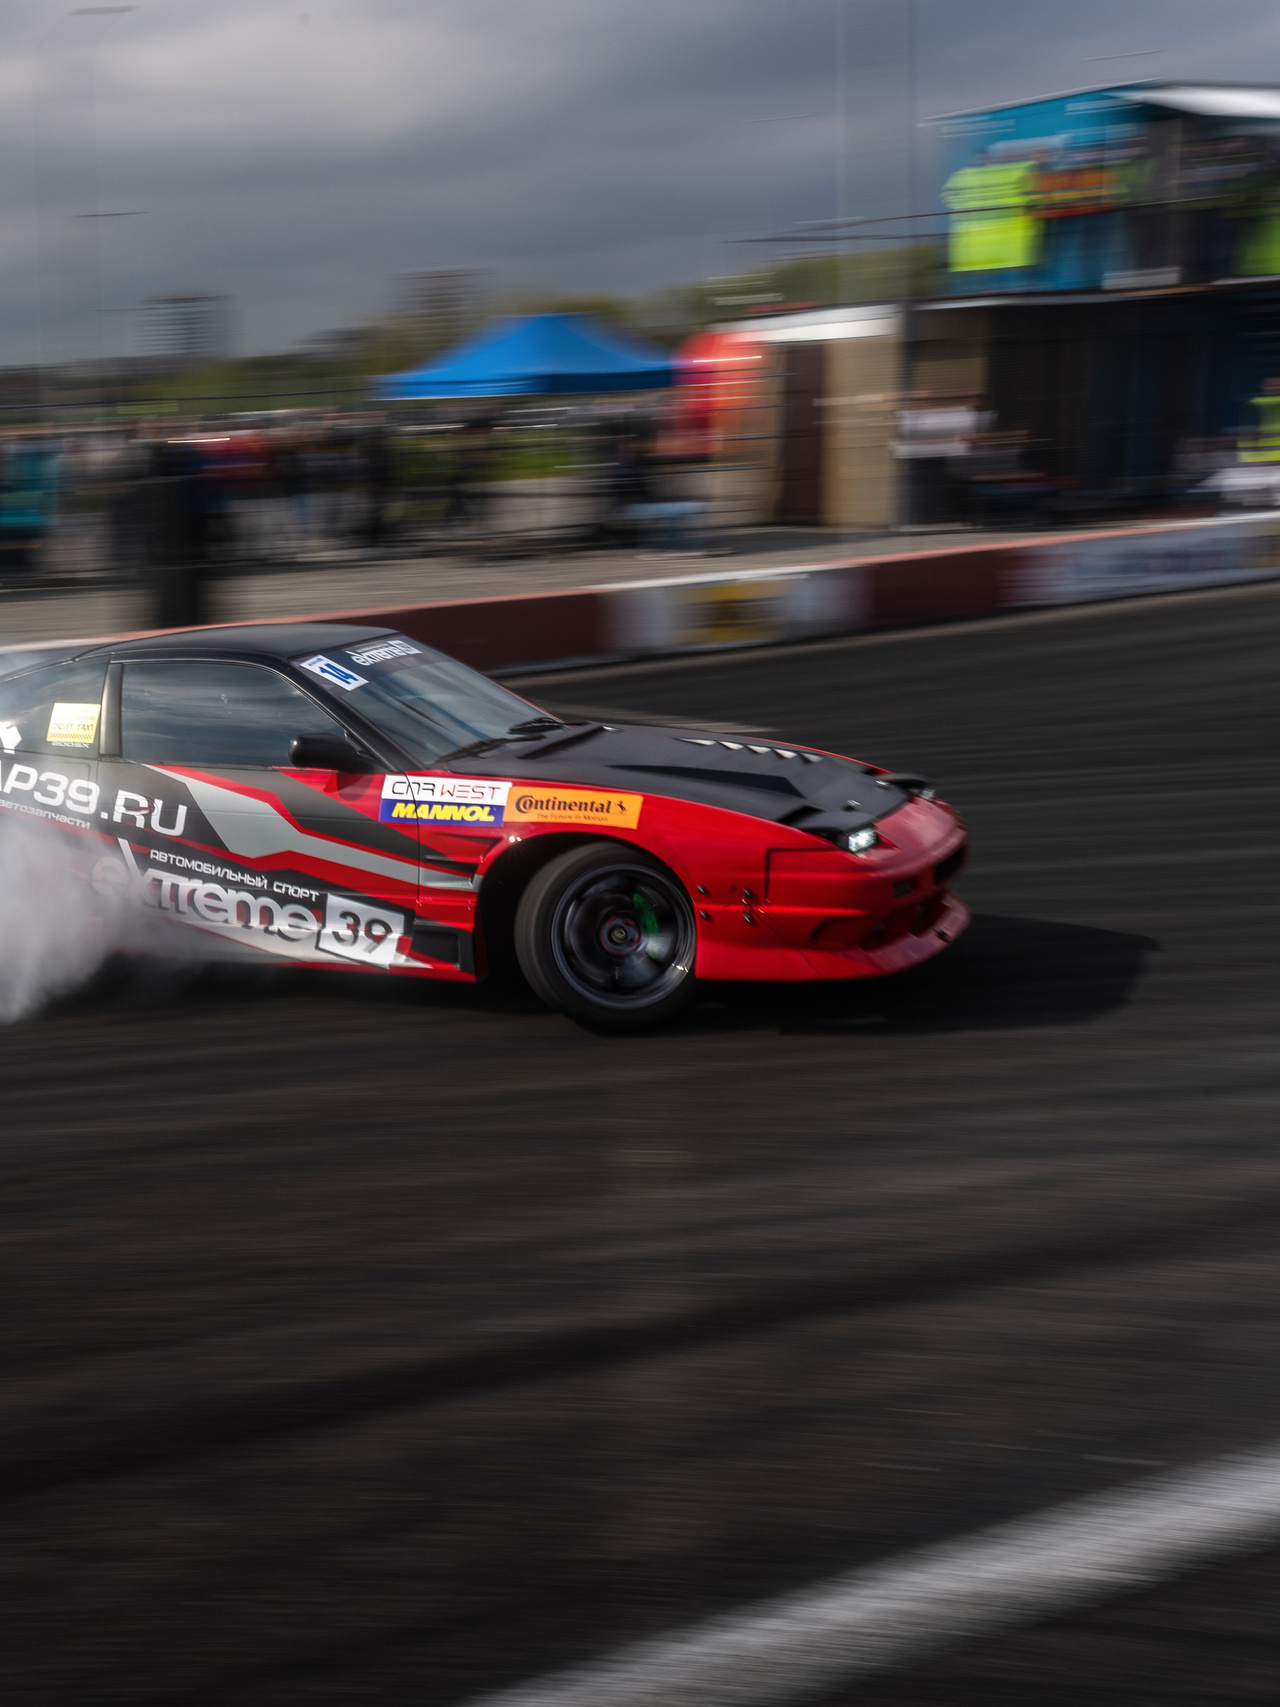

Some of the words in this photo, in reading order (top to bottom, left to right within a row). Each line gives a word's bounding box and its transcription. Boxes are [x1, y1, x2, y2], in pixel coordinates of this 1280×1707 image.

[319, 663, 359, 685] 14
[392, 781, 436, 797] CAR
[440, 783, 502, 801] WEST
[391, 802, 496, 822] MANNOL
[515, 795, 612, 814] Continental
[150, 848, 268, 890] АВТОМОБИЛЬНЫЙ
[273, 881, 320, 902] СПОРТ
[332, 911, 393, 955] 39
